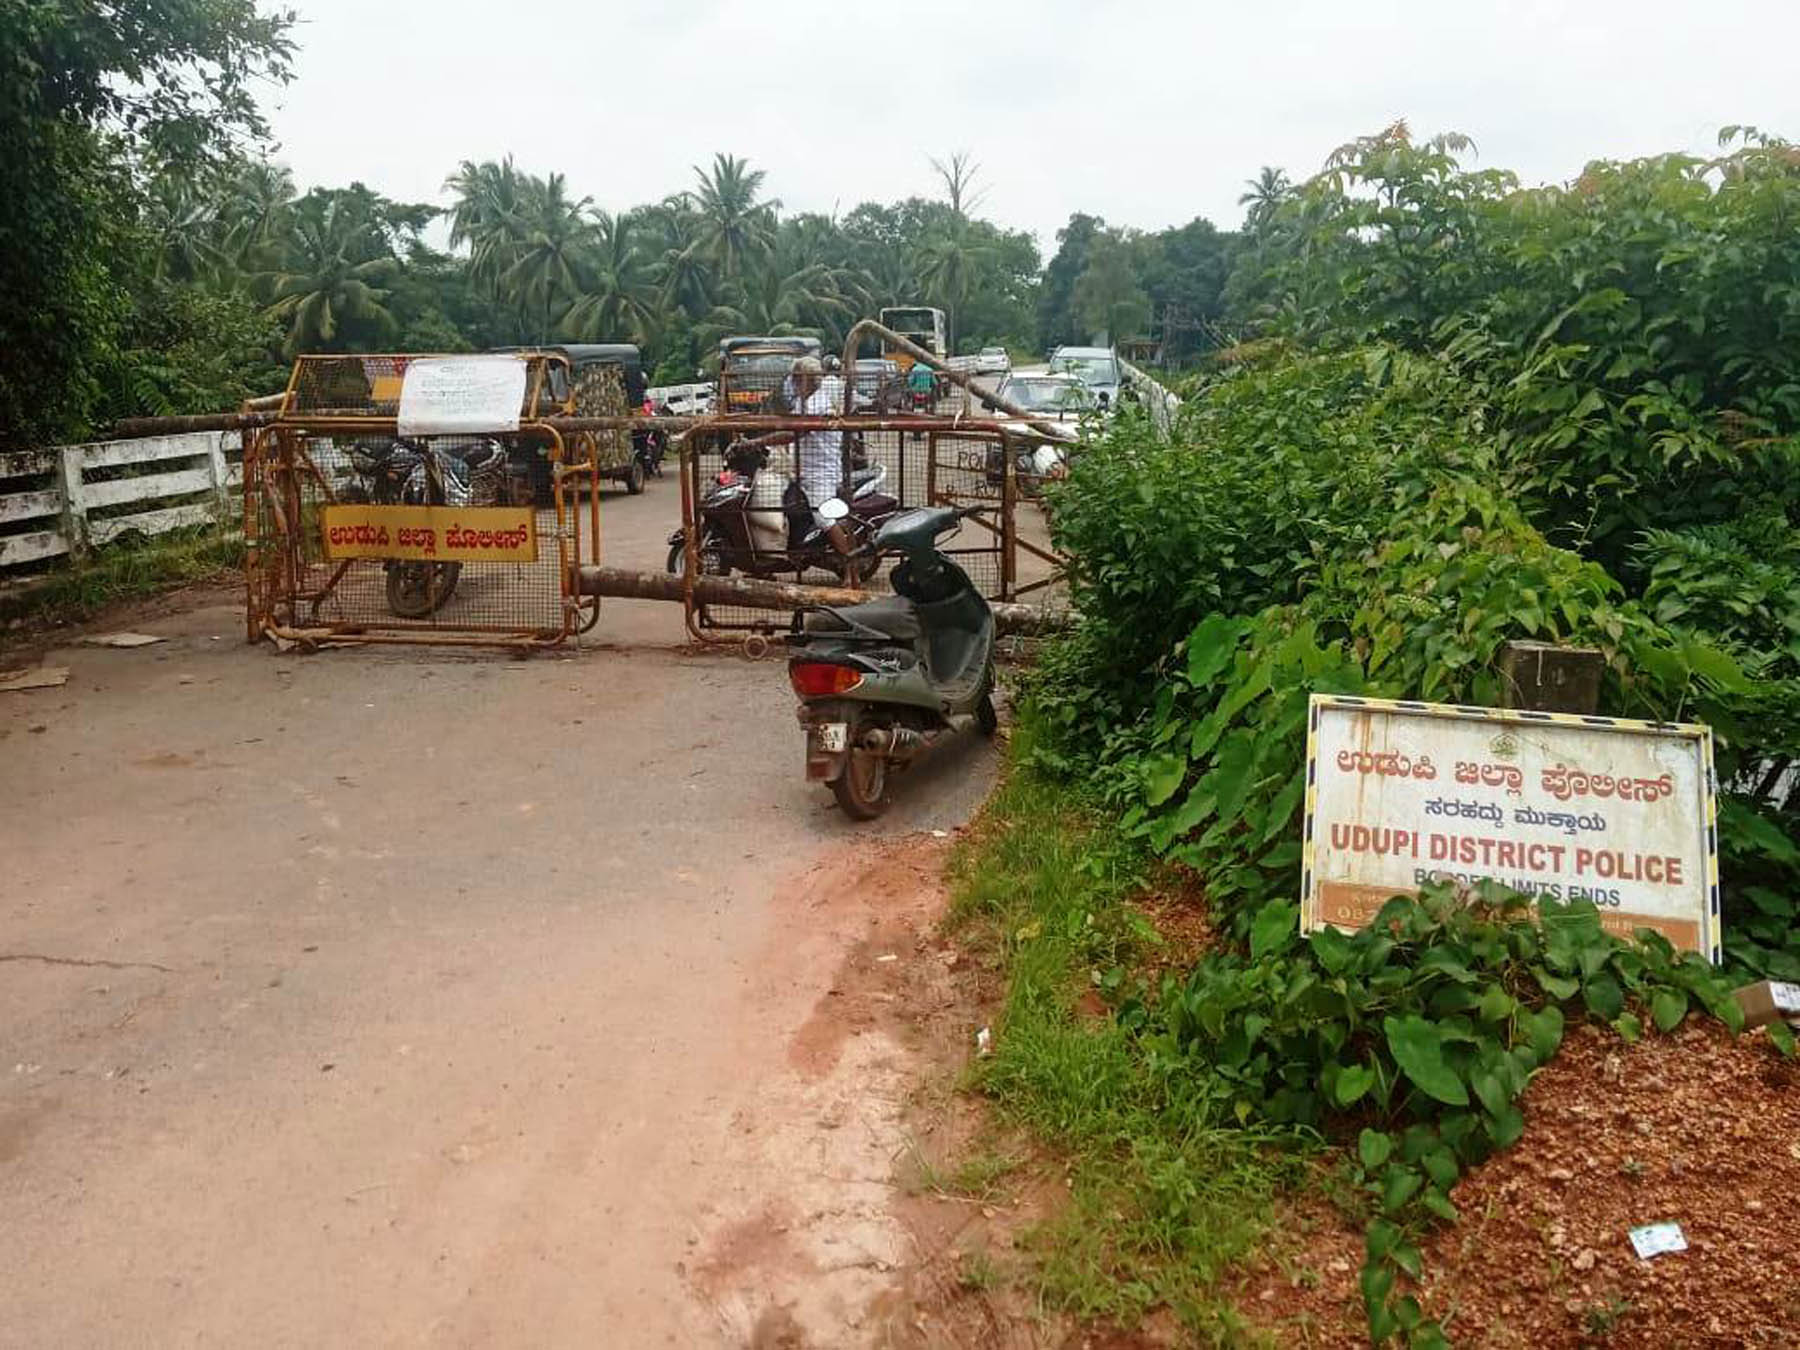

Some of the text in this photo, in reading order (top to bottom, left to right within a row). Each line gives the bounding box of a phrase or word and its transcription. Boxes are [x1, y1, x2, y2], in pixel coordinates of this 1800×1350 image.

[1337, 750, 1672, 801] ಉಡುಪಿ ಜಿಲ್ಲಾ ಪೊಲೀಸ್
[1425, 797, 1606, 835] ಸರಹದ್ದು ಮುಕ್ತಾಯ
[1331, 824, 1683, 885] UDUPI DISTRICT POLICE
